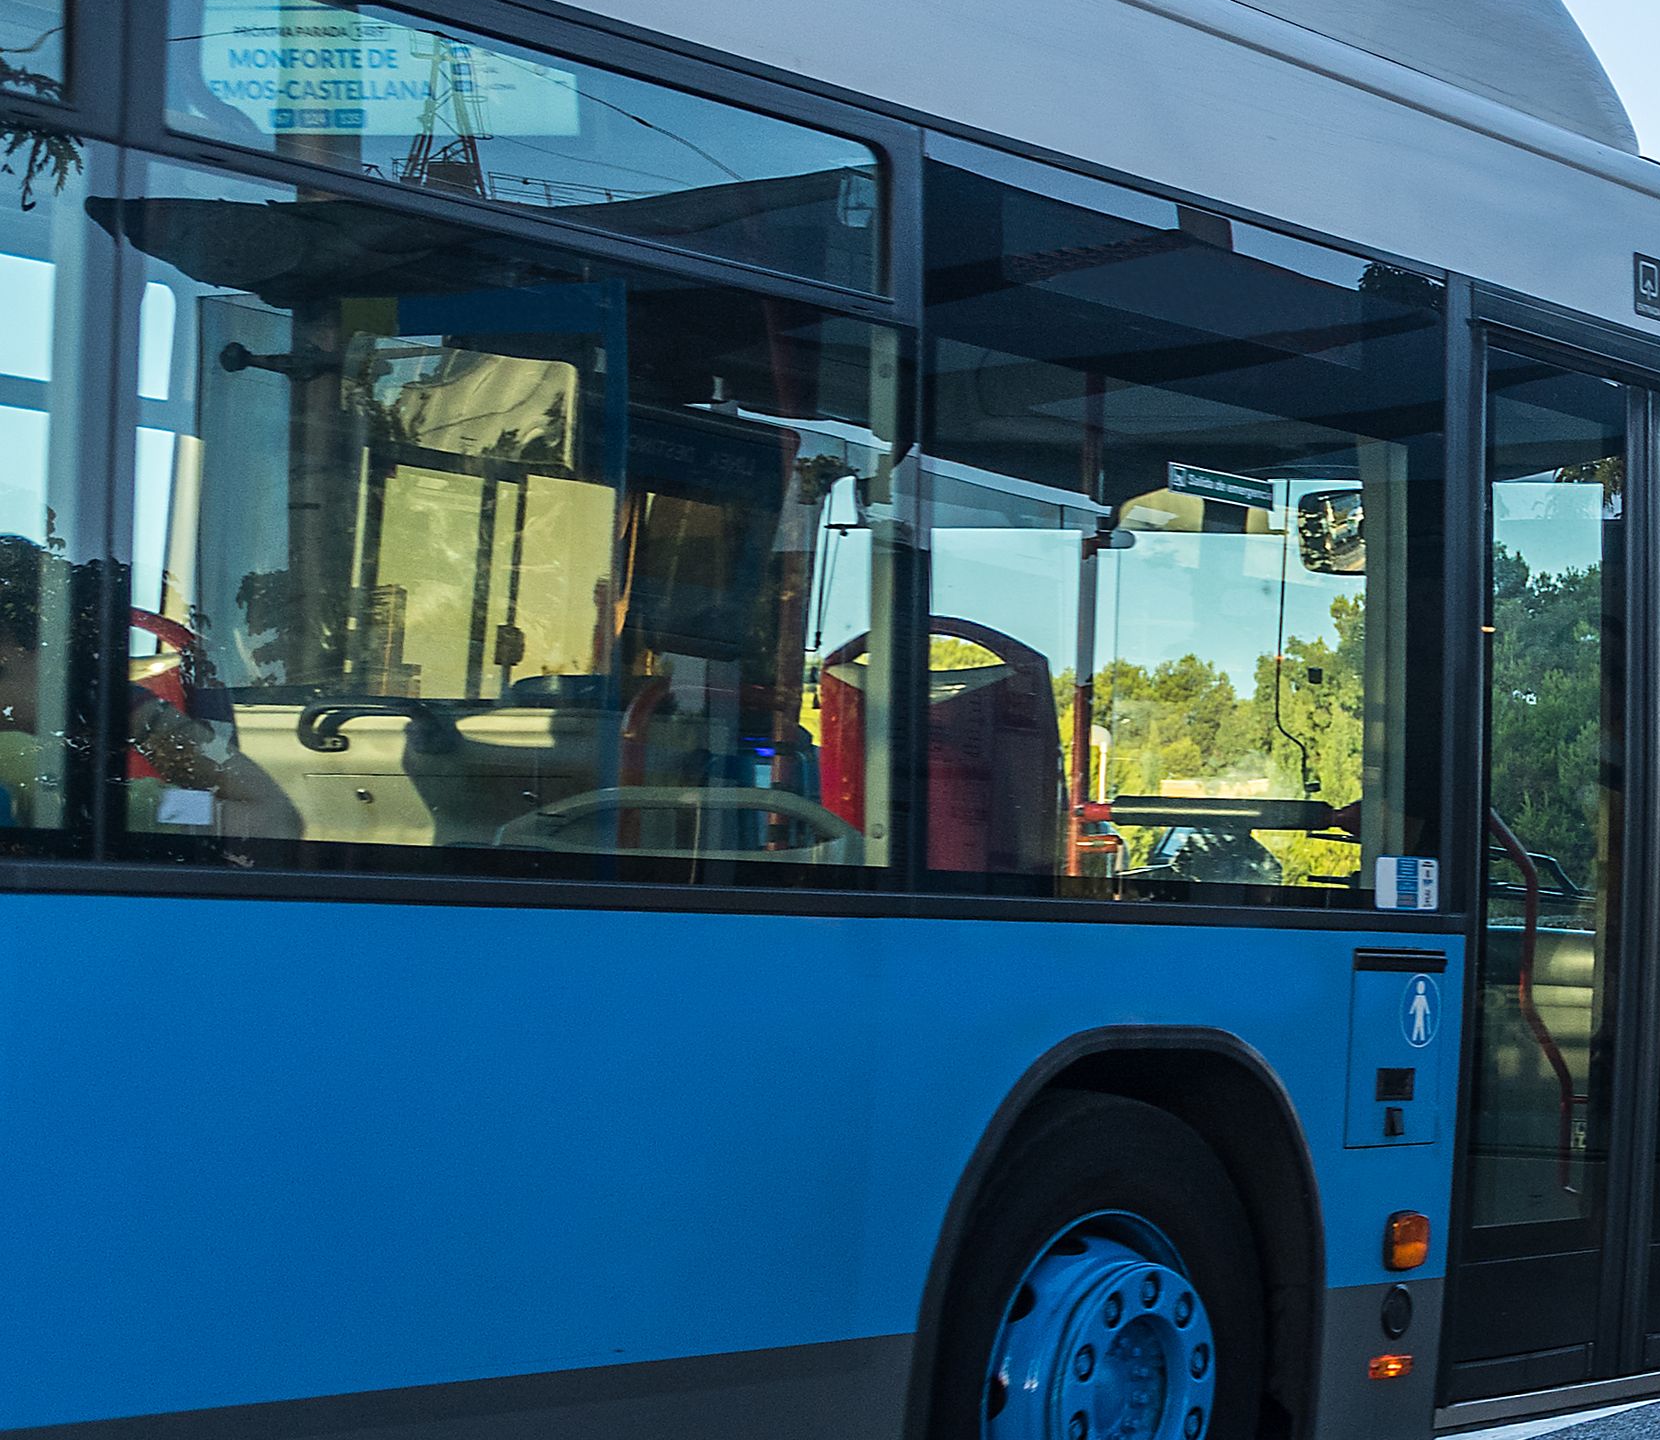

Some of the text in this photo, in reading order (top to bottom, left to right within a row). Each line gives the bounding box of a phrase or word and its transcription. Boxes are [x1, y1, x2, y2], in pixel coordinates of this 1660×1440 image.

[296, 26, 348, 37] PARADA
[228, 49, 398, 69] MONFORTE DE
[209, 80, 432, 100] EMOS-CASTELLANA
